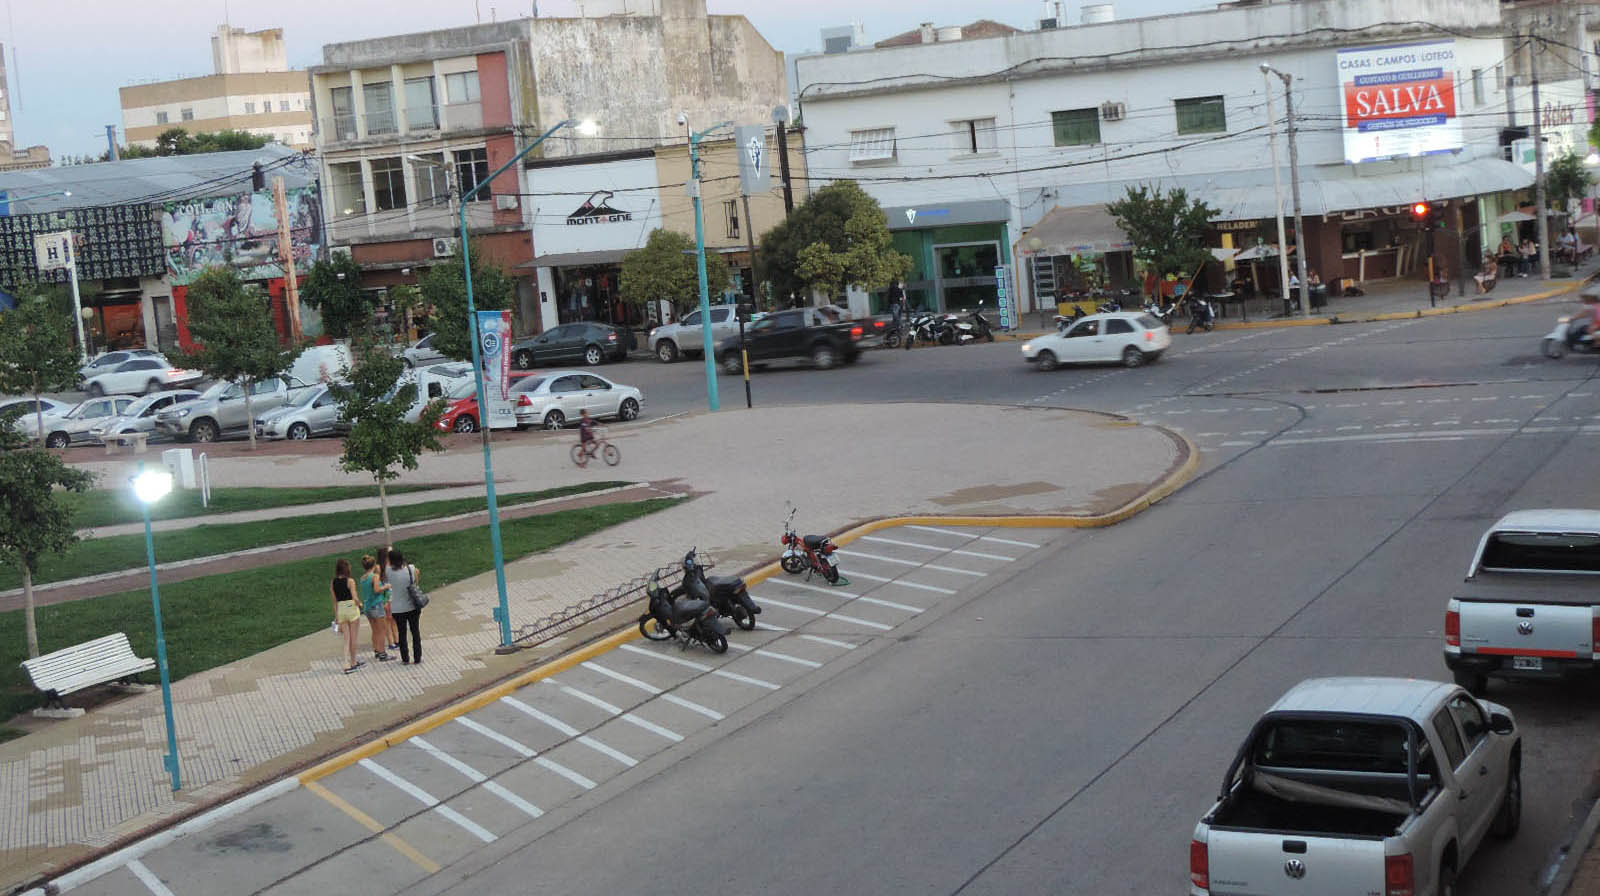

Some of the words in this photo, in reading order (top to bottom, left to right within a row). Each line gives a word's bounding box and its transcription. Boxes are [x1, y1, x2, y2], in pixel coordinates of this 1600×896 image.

[1340, 59, 1371, 70] CASAS
[1376, 54, 1416, 66] CAMPOS
[1421, 50, 1454, 62] LOTEOS
[1356, 85, 1445, 117] SALVA
